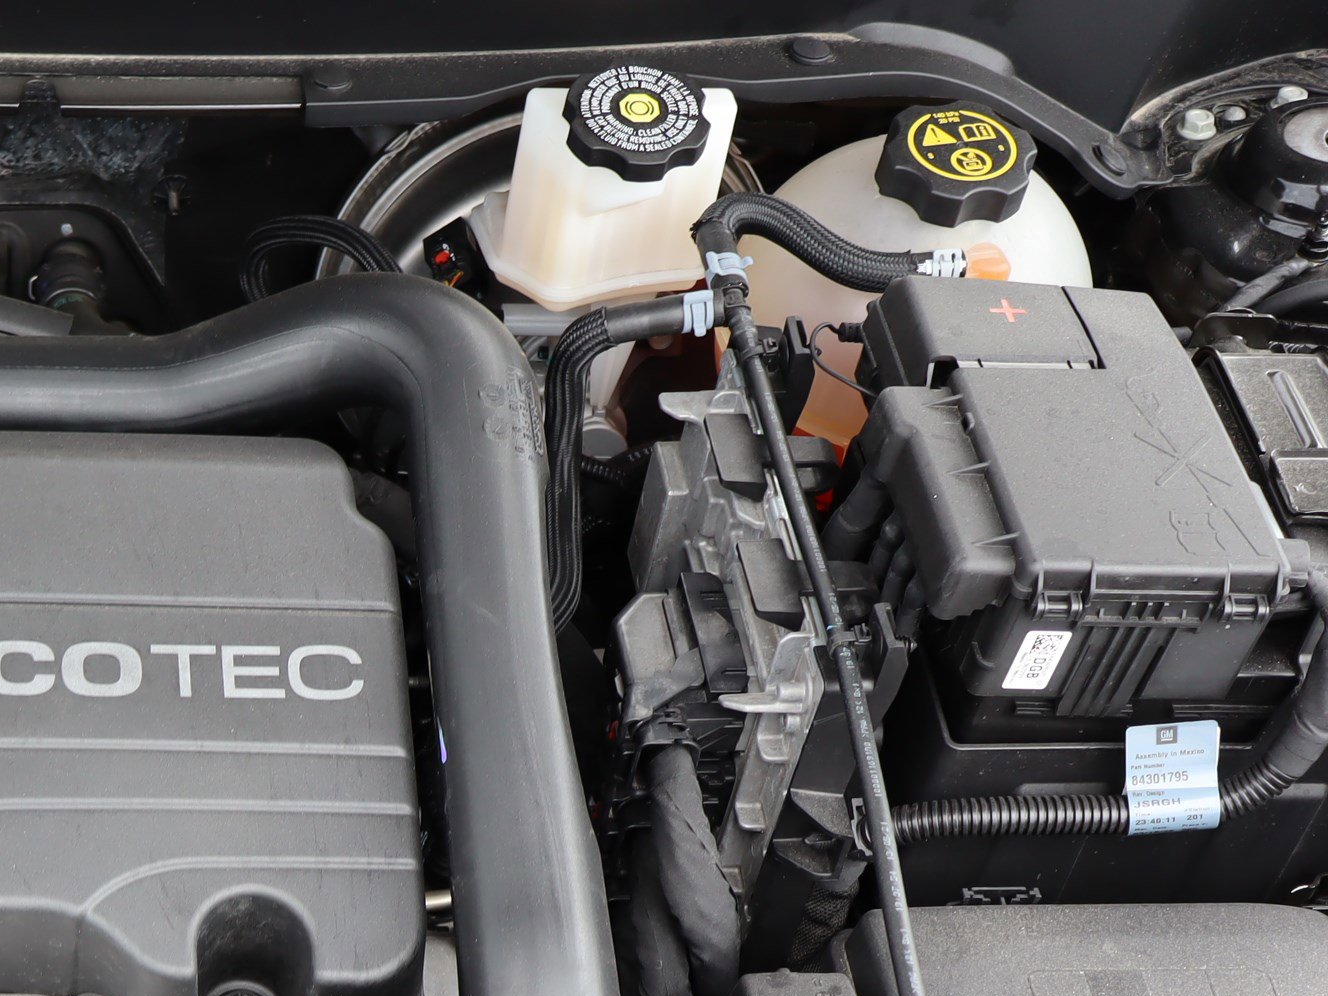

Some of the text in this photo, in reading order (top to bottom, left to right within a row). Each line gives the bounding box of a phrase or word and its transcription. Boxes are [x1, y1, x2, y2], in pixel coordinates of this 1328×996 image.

[617, 66, 628, 74] LE
[628, 65, 663, 78] BOUCHON
[662, 73, 684, 88] AVANT
[680, 86, 691, 96] LA
[618, 74, 629, 82] DU
[630, 74, 658, 84] LIQUIDE
[657, 79, 669, 88] DE
[641, 82, 663, 94] BIDON
[594, 115, 608, 126] CAP
[603, 124, 630, 142] BEFORE
[638, 126, 662, 137] CLEAN
[597, 130, 618, 146] FLUID
[616, 140, 638, 152] FROM
[638, 144, 645, 152] A
[645, 140, 672, 152] SEALED
[1160, 729, 1174, 739] GM
[1131, 771, 1189, 786] 84301795
[1135, 817, 1176, 826] 23:40:11
